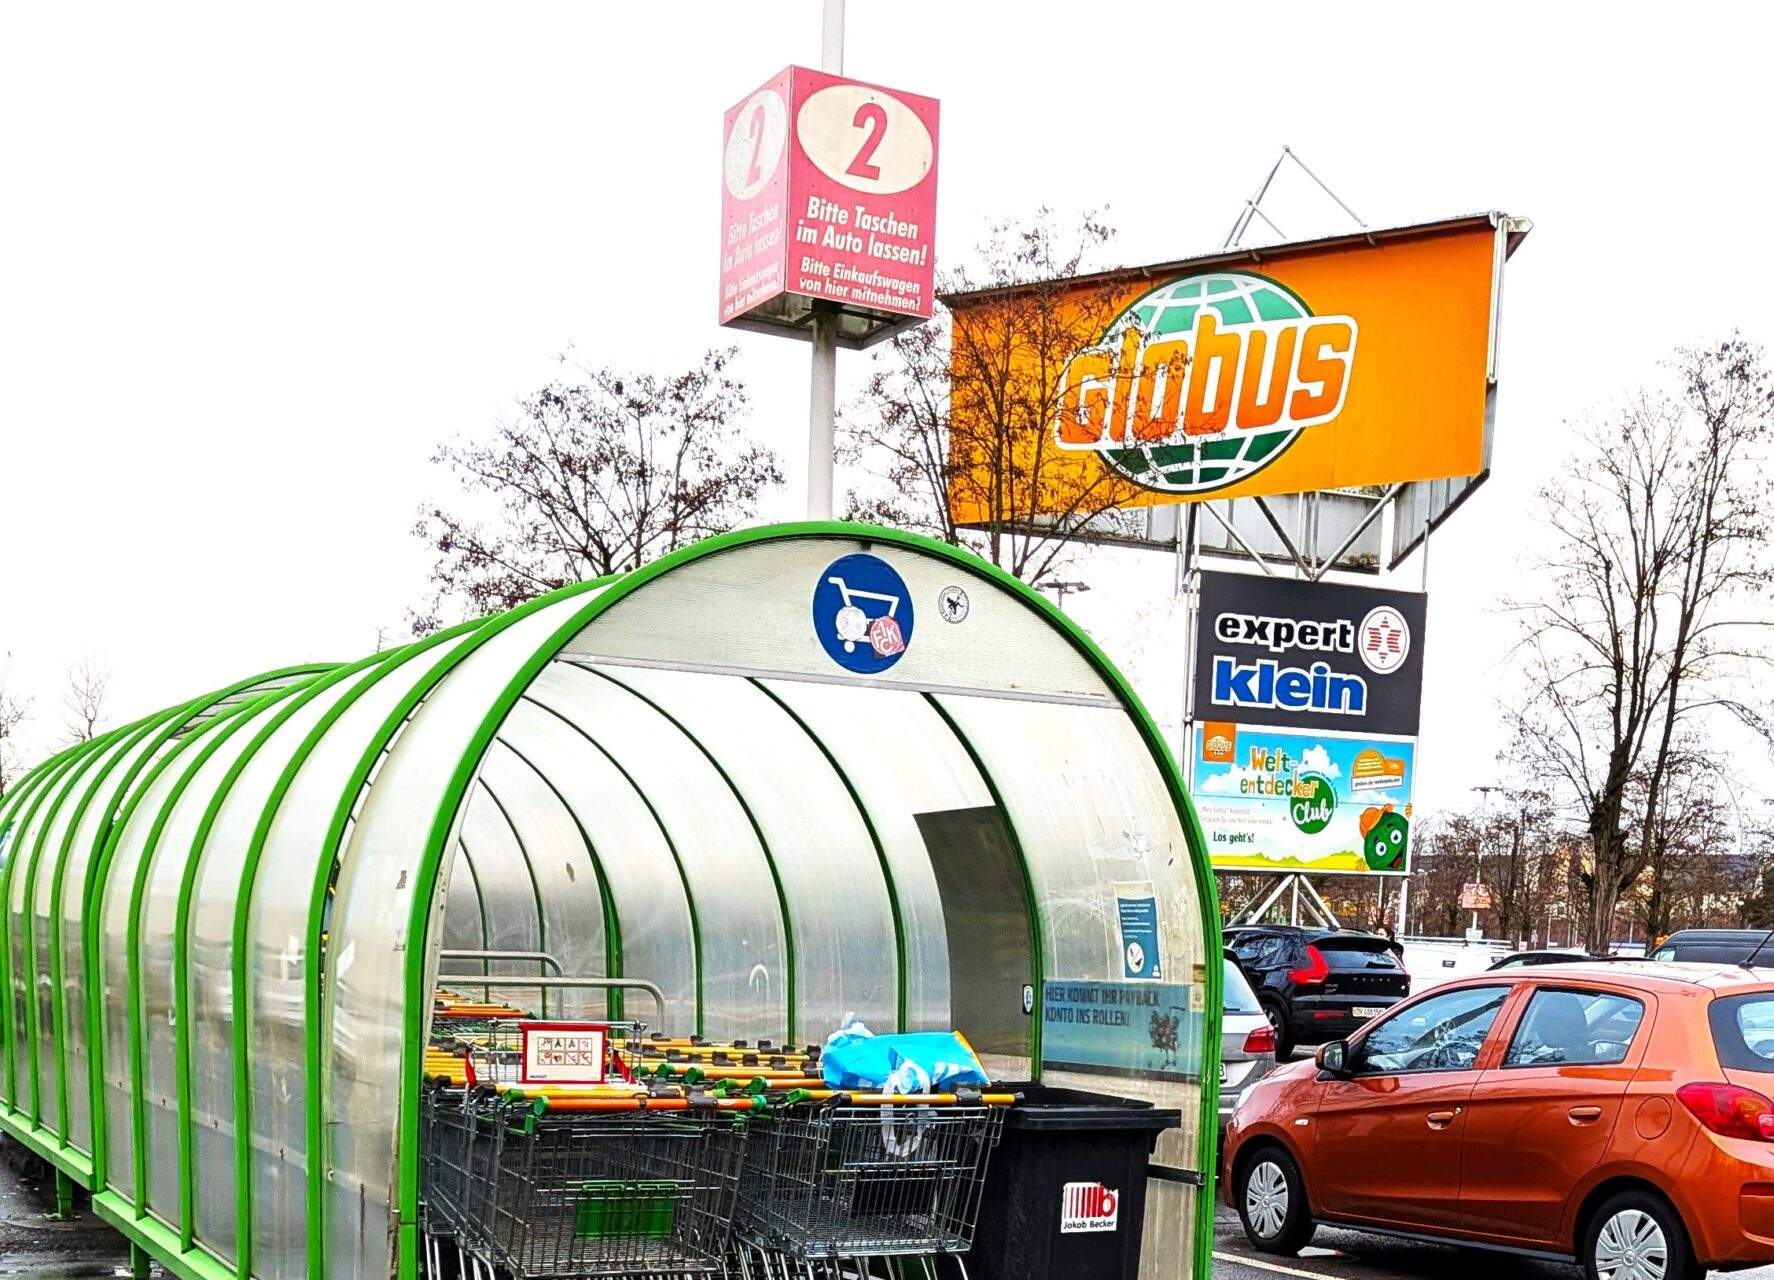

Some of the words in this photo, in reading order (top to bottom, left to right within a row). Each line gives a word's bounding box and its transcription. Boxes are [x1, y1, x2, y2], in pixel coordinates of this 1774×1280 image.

[744, 104, 765, 188] 2
[845, 103, 887, 181] 2
[807, 196, 848, 225] Bitte
[855, 205, 918, 240] Taschen
[734, 242, 753, 268] Auto
[796, 220, 817, 244] im
[822, 225, 862, 257] Auto
[868, 234, 927, 266] lassen!
[801, 256, 830, 277] Bitte
[833, 263, 920, 295] Einkaufswagen
[800, 280, 820, 294] von
[824, 278, 849, 298] hier
[852, 285, 921, 311] mitnehmen!
[1217, 613, 1352, 651] expert
[1213, 657, 1366, 713] klein
[1240, 769, 1319, 798] entdecker
[1293, 798, 1333, 824] Club
[1213, 831, 1227, 842] Los
[1229, 832, 1255, 844] geht's!
[1045, 986, 1065, 1002] HIER
[1102, 989, 1118, 1005] IHR
[1045, 1007, 1074, 1023] KONTO
[1076, 1009, 1091, 1025] INS
[1064, 1221, 1087, 1229] Jakob
[1089, 1220, 1114, 1228] Becker
